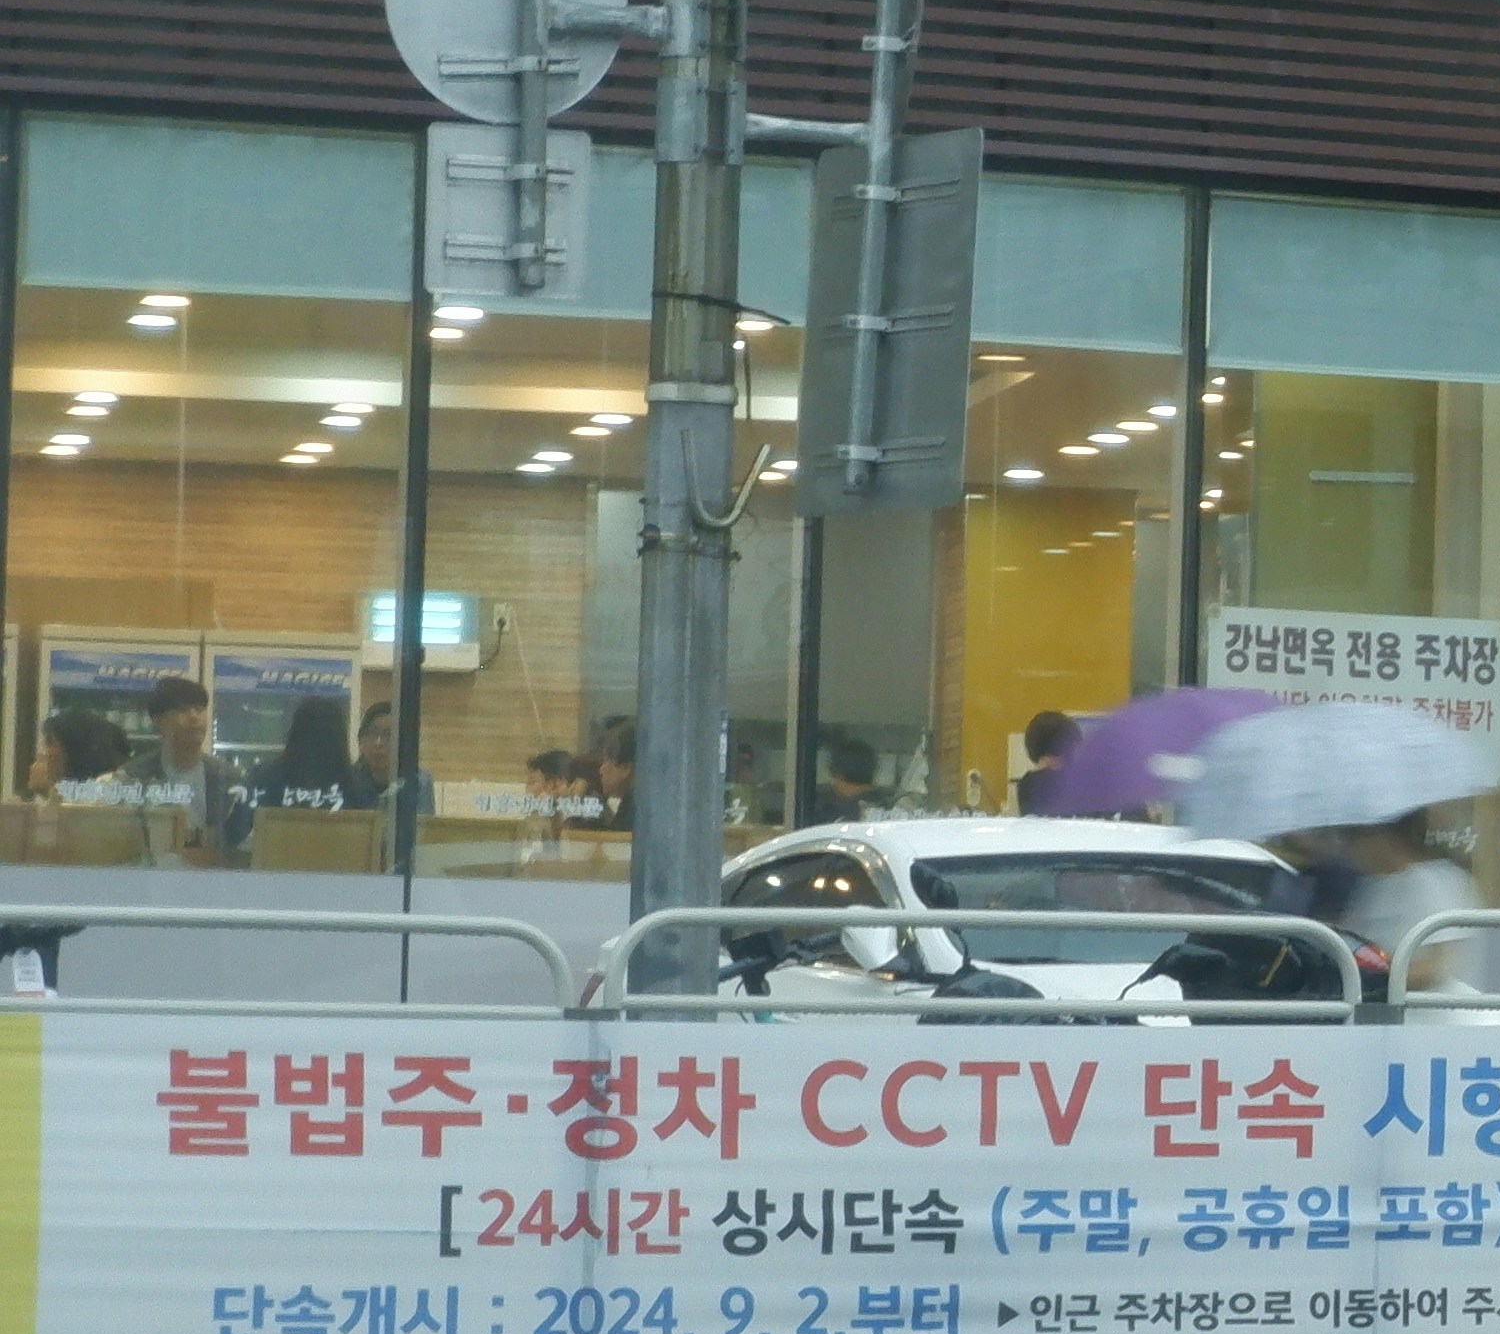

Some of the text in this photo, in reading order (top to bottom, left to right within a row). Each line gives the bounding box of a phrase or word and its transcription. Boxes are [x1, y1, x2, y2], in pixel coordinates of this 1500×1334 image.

[1225, 624, 1499, 685] 강남면옥 전용 주차장
[156, 1049, 757, 1161] 불법주·정차
[800, 1059, 1100, 1149] CCTV
[1143, 1057, 1327, 1160] 단속
[712, 1185, 966, 1256] 상시단속
[990, 1184, 1150, 1257] (주말,
[1176, 1185, 1352, 1252] 공휴일
[1028, 1293, 1102, 1332] 인근
[1113, 1292, 1296, 1334] 주차장으로
[1307, 1289, 1450, 1329] 이동하여
